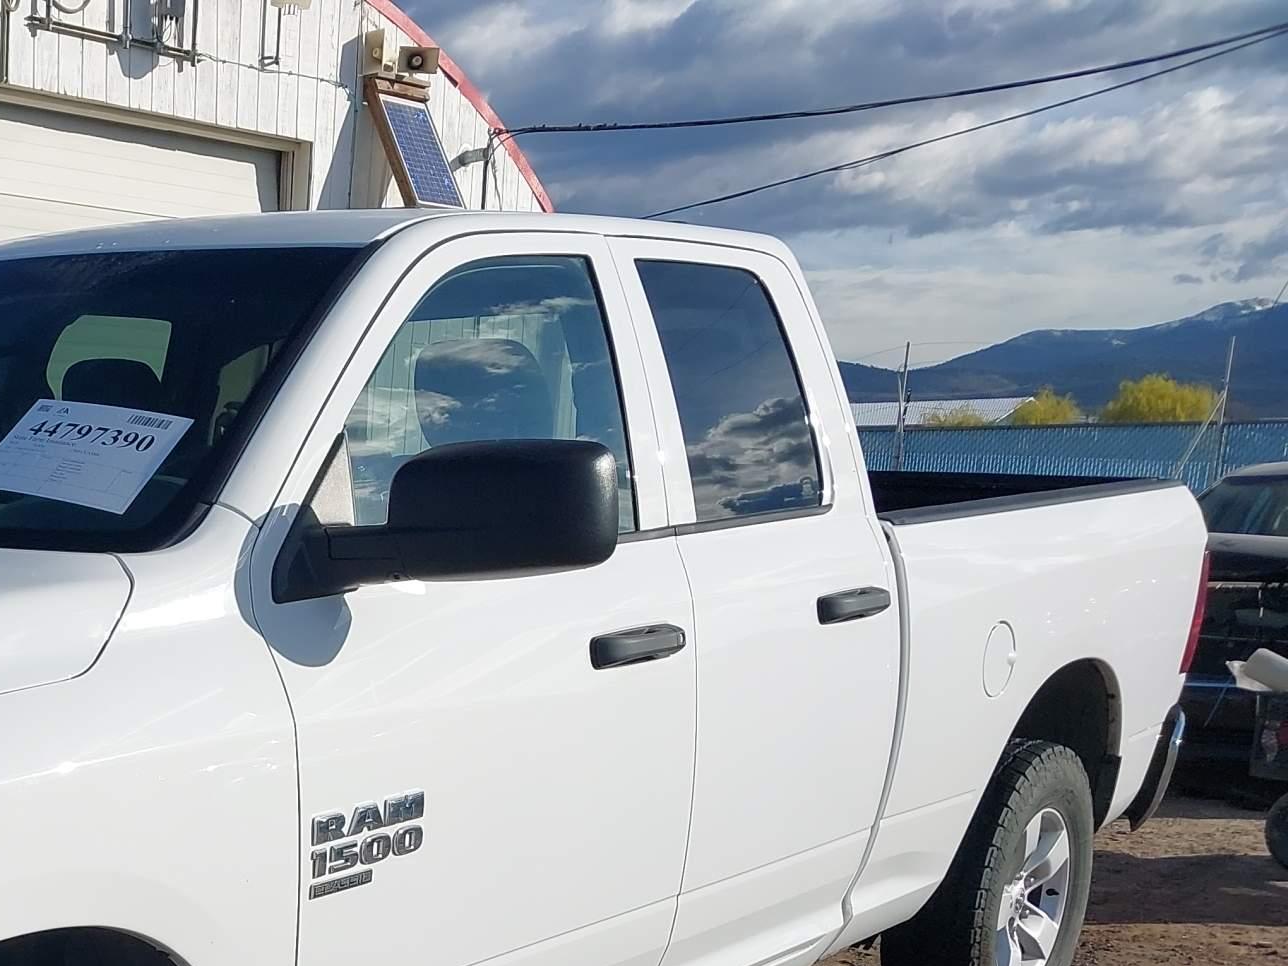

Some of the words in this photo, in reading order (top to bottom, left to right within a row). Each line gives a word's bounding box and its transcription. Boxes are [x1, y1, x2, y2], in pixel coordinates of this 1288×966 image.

[29, 419, 155, 452] 44797390
[311, 790, 425, 847] RAM
[310, 824, 424, 879] 1500
